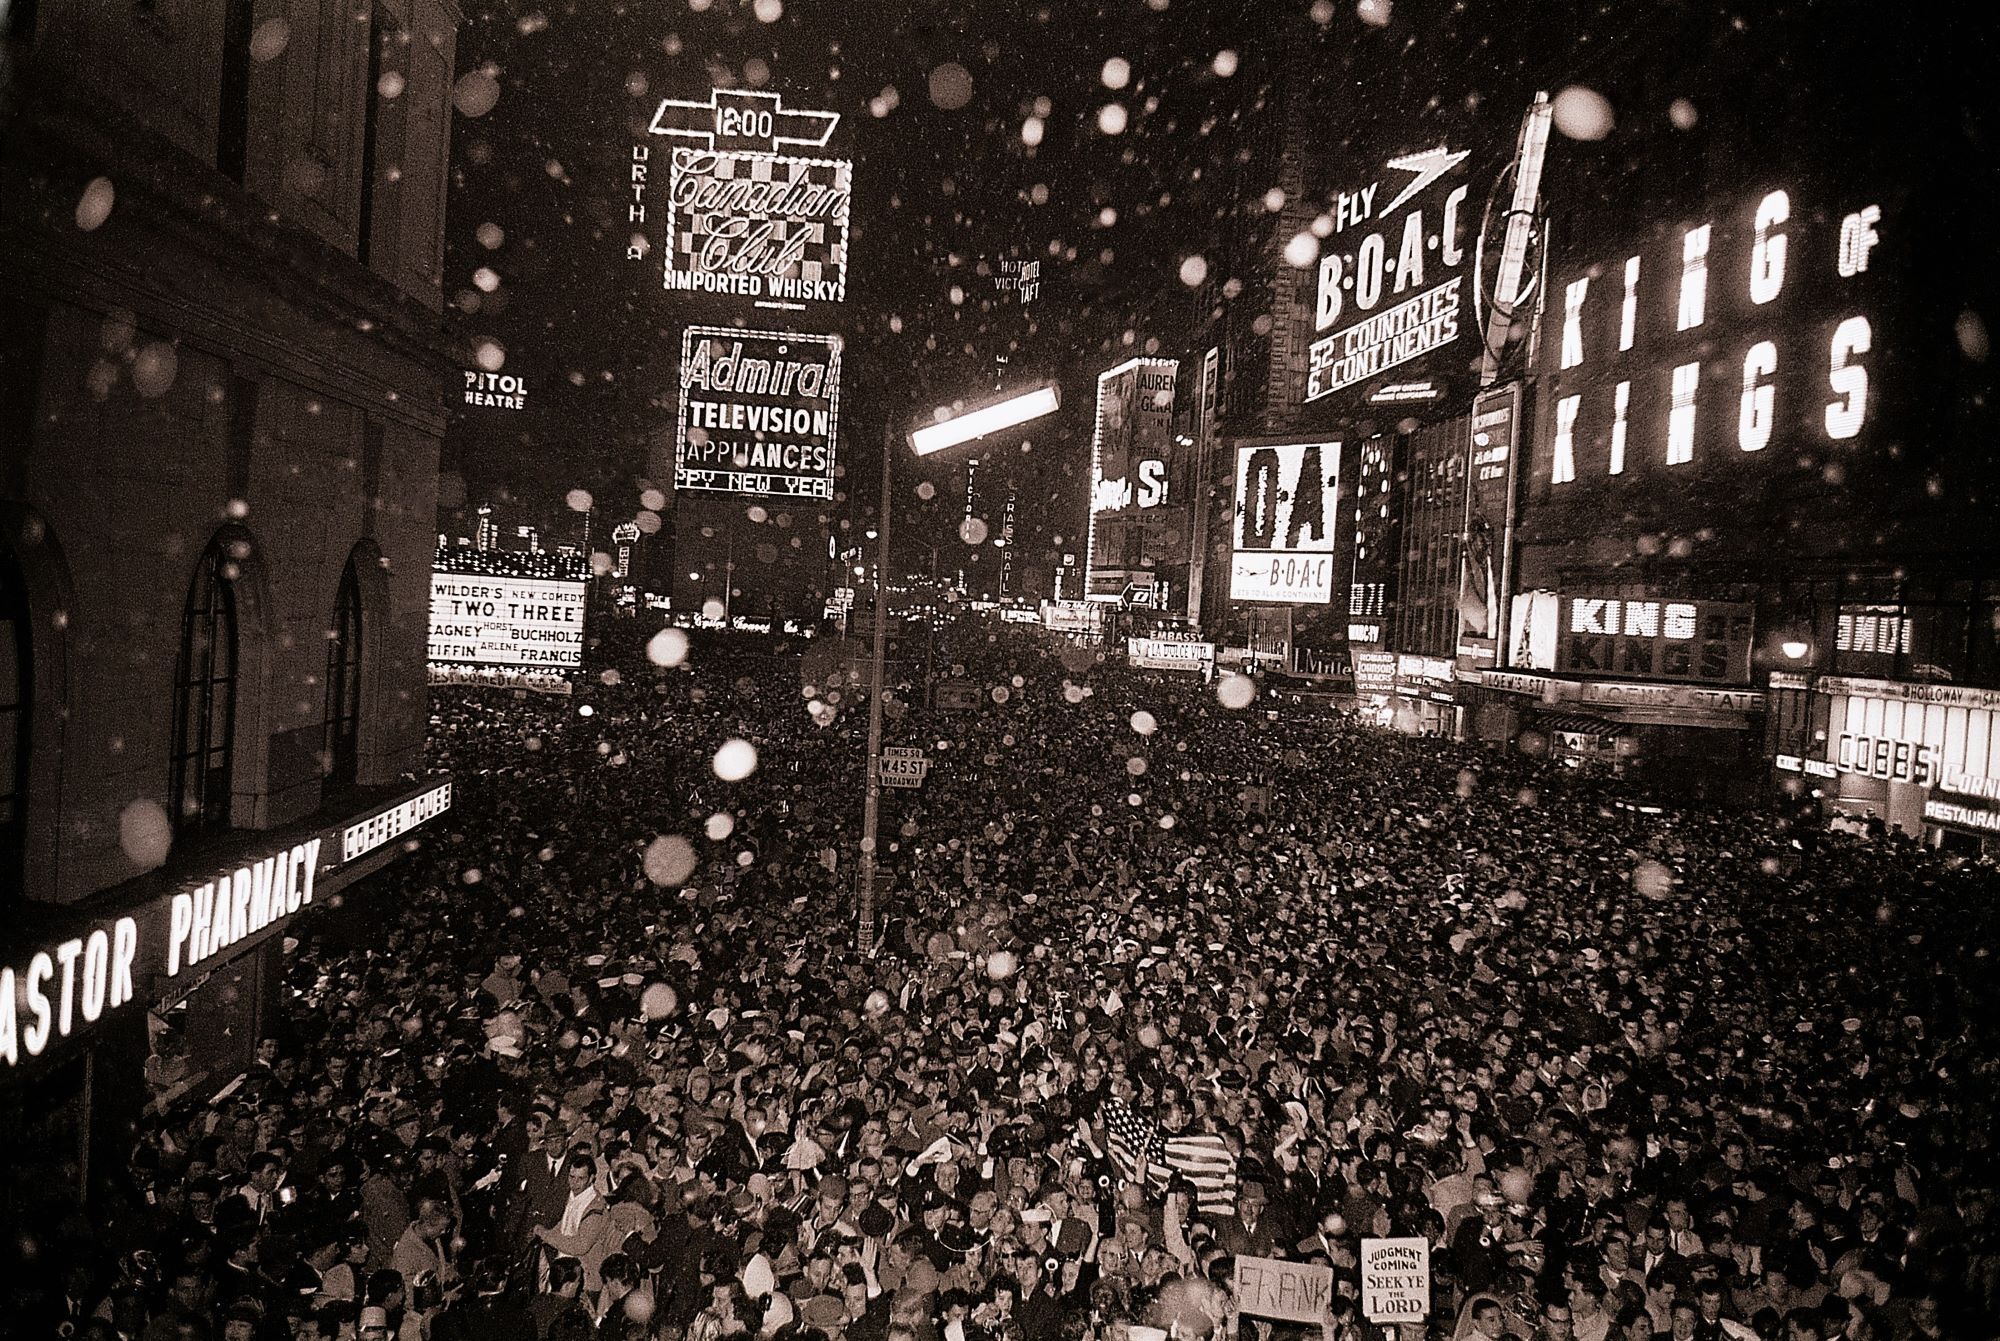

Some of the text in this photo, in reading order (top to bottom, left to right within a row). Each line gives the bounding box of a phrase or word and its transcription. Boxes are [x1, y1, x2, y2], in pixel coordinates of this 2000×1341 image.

[715, 107, 773, 138] 12:00
[671, 150, 848, 218] Canadian
[1336, 182, 1378, 233] FLY
[700, 213, 814, 275] Club
[671, 270, 839, 302] IMPORTED WHISKY
[1560, 189, 1881, 370] KING OF
[1309, 281, 1463, 371] 52 COUNTRIES
[1307, 312, 1459, 398] 6 CONTINENTS
[681, 339, 839, 399] Admiral
[465, 391, 524, 410] HEATRE
[1551, 316, 1873, 484] KINGS
[690, 402, 828, 435] TELEVISION
[687, 440, 827, 471] APPLIANCES
[729, 473, 770, 493] NEW
[435, 584, 584, 602] WILDER'S NEW COMEDY
[1571, 598, 1697, 639] KING
[484, 622, 513, 631] HORST
[511, 628, 583, 643] BUCHHOLZ
[1150, 631, 1204, 642] EMBASSY
[428, 642, 581, 662] TIFFIN ARLENE FRANCIS
[1570, 637, 1727, 677] KINGS
[1488, 673, 1523, 691] LOEW'S
[1687, 690, 1766, 710] STATE
[1910, 686, 1963, 704] HOLLOWAY
[888, 748, 908, 757] TIMES
[910, 761, 923, 774] ST
[885, 777, 919, 786] BROADWAY
[346, 785, 450, 859] COFFEE HOUSE
[1925, 801, 2000, 831] RESTAURA
[168, 838, 322, 977] PHARMACY
[1367, 1246, 1422, 1265] JUDGMENT
[1374, 1259, 1417, 1271] COMING
[1367, 1274, 1425, 1290] SEEK YE
[1371, 1295, 1422, 1314] LORD
[1389, 1291, 1405, 1299] THE
